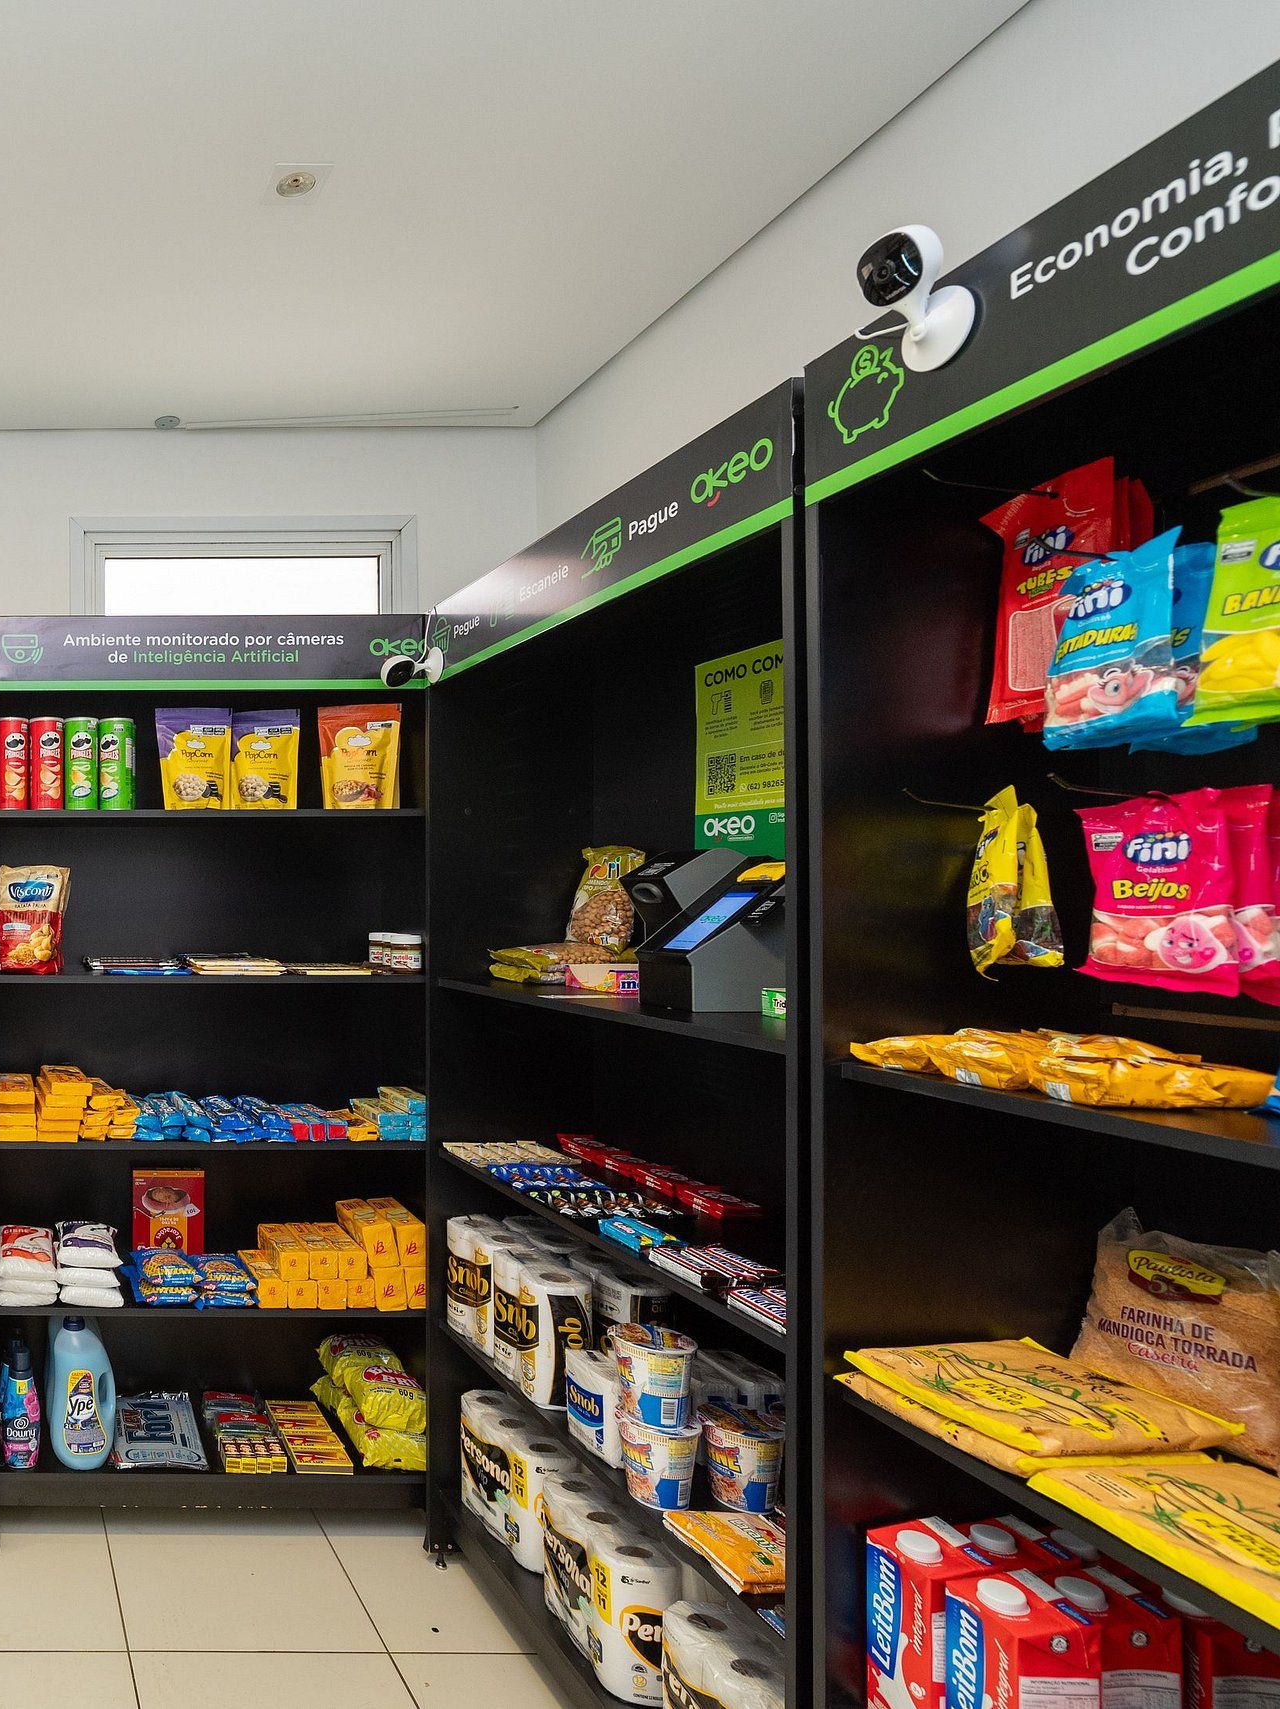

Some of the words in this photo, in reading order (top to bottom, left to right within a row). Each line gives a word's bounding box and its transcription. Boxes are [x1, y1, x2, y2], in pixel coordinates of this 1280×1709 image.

[1010, 150, 1249, 299] Economia,
[1125, 175, 1280, 276] Confo
[690, 437, 773, 504] okeo
[628, 501, 679, 541] Pague
[520, 563, 569, 601] Escaneie
[1016, 566, 1075, 595] TUBES
[63, 632, 141, 646] Ambiente
[146, 633, 241, 646] monitorado
[245, 636, 273, 649] por
[276, 631, 344, 646] câmeras
[453, 615, 480, 639] Pegue
[108, 649, 128, 663] de
[133, 648, 226, 666] Inteligência
[231, 648, 300, 663] Artificial
[704, 664, 748, 687] COMO
[751, 752, 766, 761] caso
[768, 750, 777, 758] de
[704, 815, 756, 837] okeo
[9, 884, 54, 898] Visconti
[1112, 879, 1190, 903] Beijos
[447, 1255, 489, 1296] Snob
[1133, 1255, 1218, 1285] Paulista
[1121, 1305, 1186, 1336] FARINHA
[1189, 1322, 1216, 1342] DE
[1098, 1318, 1168, 1352] MANDIOCA
[1170, 1336, 1257, 1373] TORRADA
[569, 1383, 601, 1417] Snob
[6, 1427, 37, 1439] Downy
[513, 1463, 525, 1478] 12
[595, 1568, 607, 1588] 12
[871, 1556, 897, 1673] LeitBom
[905, 1580, 924, 1656] integral
